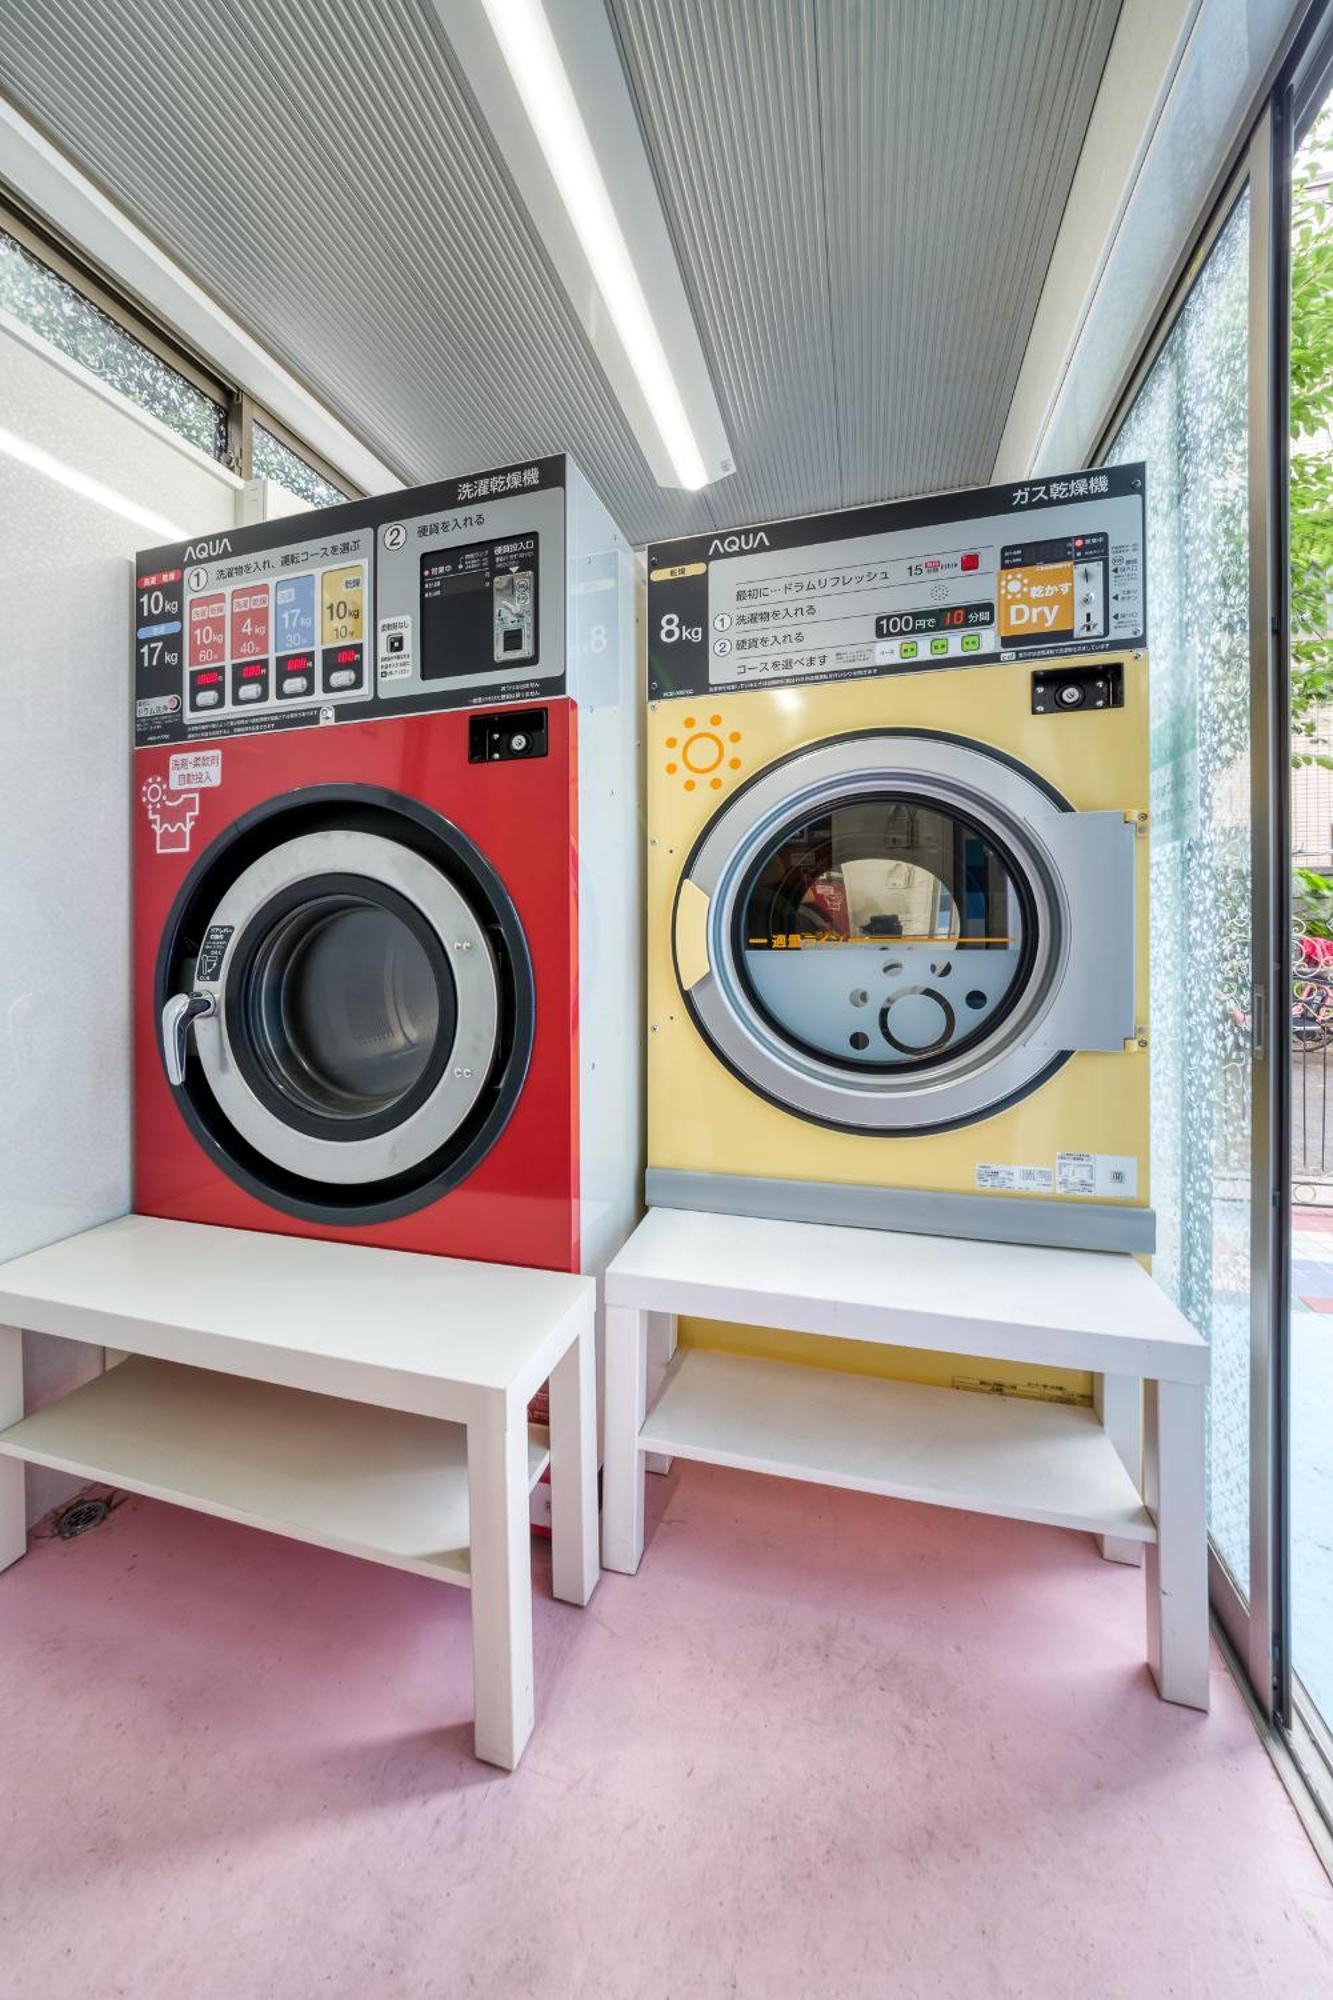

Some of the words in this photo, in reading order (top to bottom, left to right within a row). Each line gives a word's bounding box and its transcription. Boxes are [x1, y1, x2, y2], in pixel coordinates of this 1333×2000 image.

[457, 467, 540, 501] 洗濯乾燥機
[1012, 474, 1109, 506] ガス乾燥機
[417, 514, 485, 538] 硬貨を入れる
[183, 537, 233, 562] AQUA
[708, 531, 770, 556] AQUA
[907, 565, 923, 577] 15
[660, 613, 702, 643] 8kg
[735, 604, 816, 627] 洗濯物を入れる
[1010, 603, 1059, 628] Dry
[735, 629, 805, 652] 硬貨を入れる
